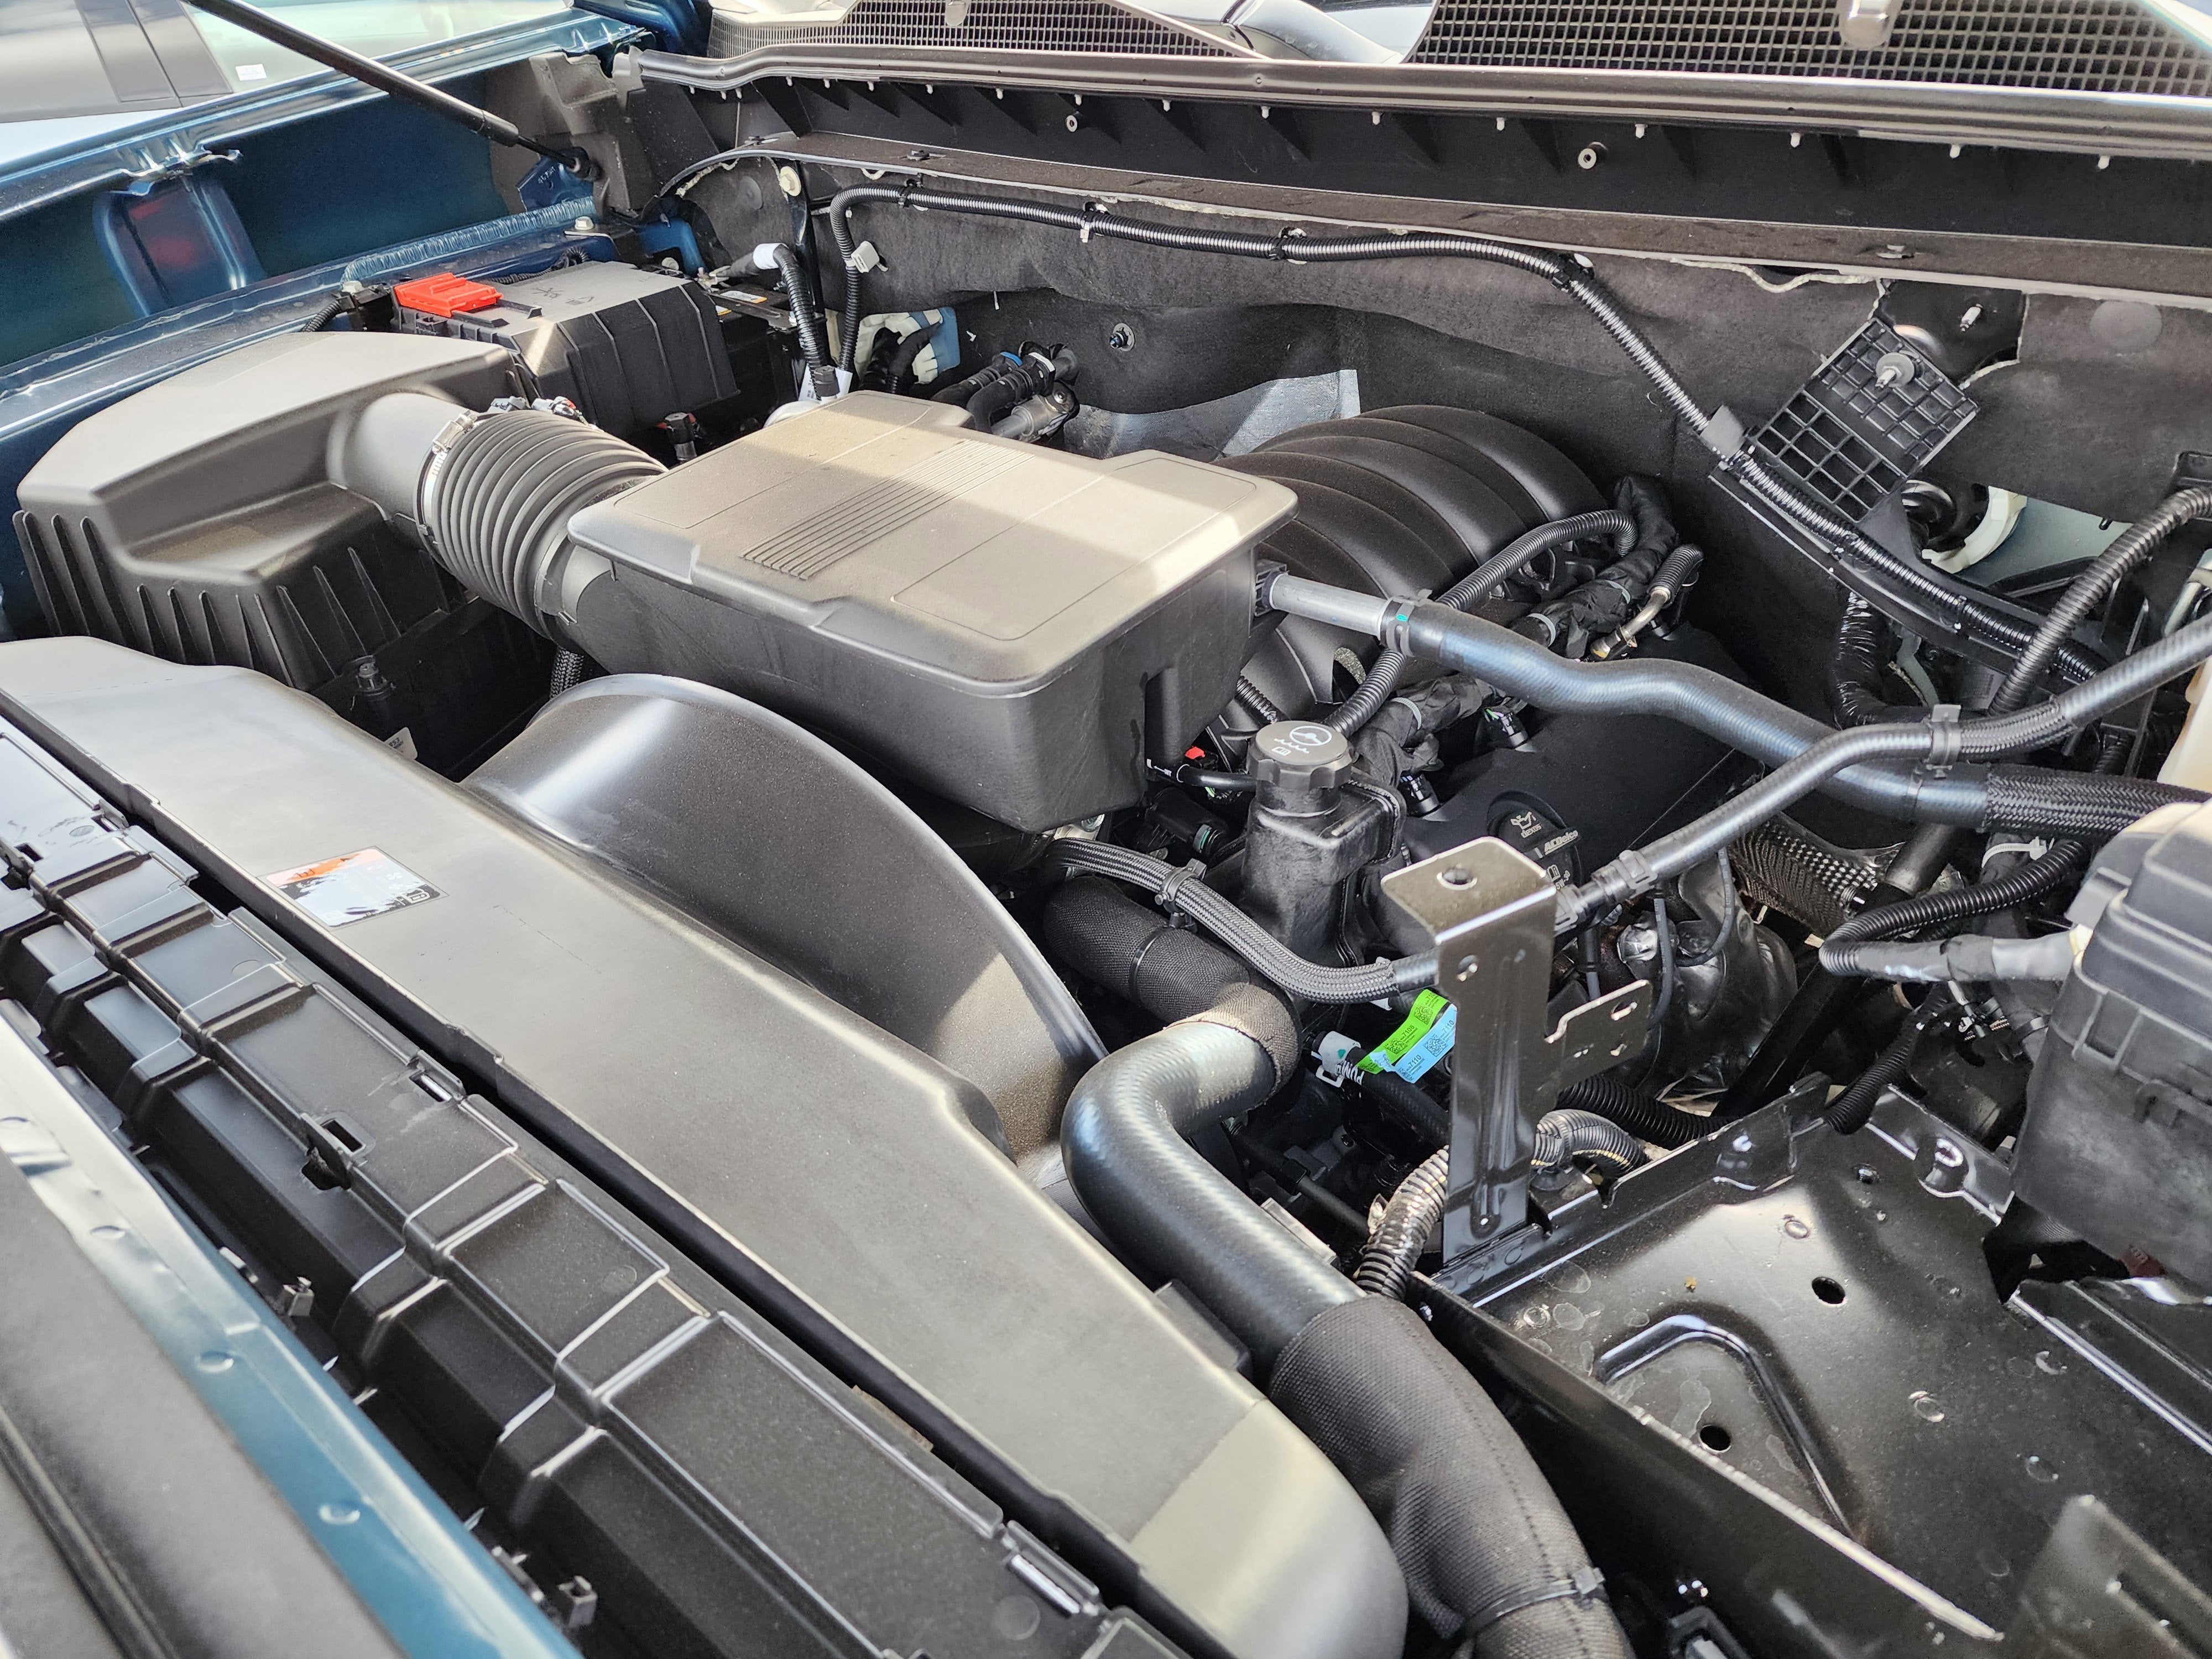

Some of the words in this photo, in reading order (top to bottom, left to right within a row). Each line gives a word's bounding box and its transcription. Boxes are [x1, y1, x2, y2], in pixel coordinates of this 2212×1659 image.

[1544, 830, 1578, 853] ACDelco
[1555, 870, 1571, 890] 5W-30
[1408, 1054, 1422, 1067] 7110
